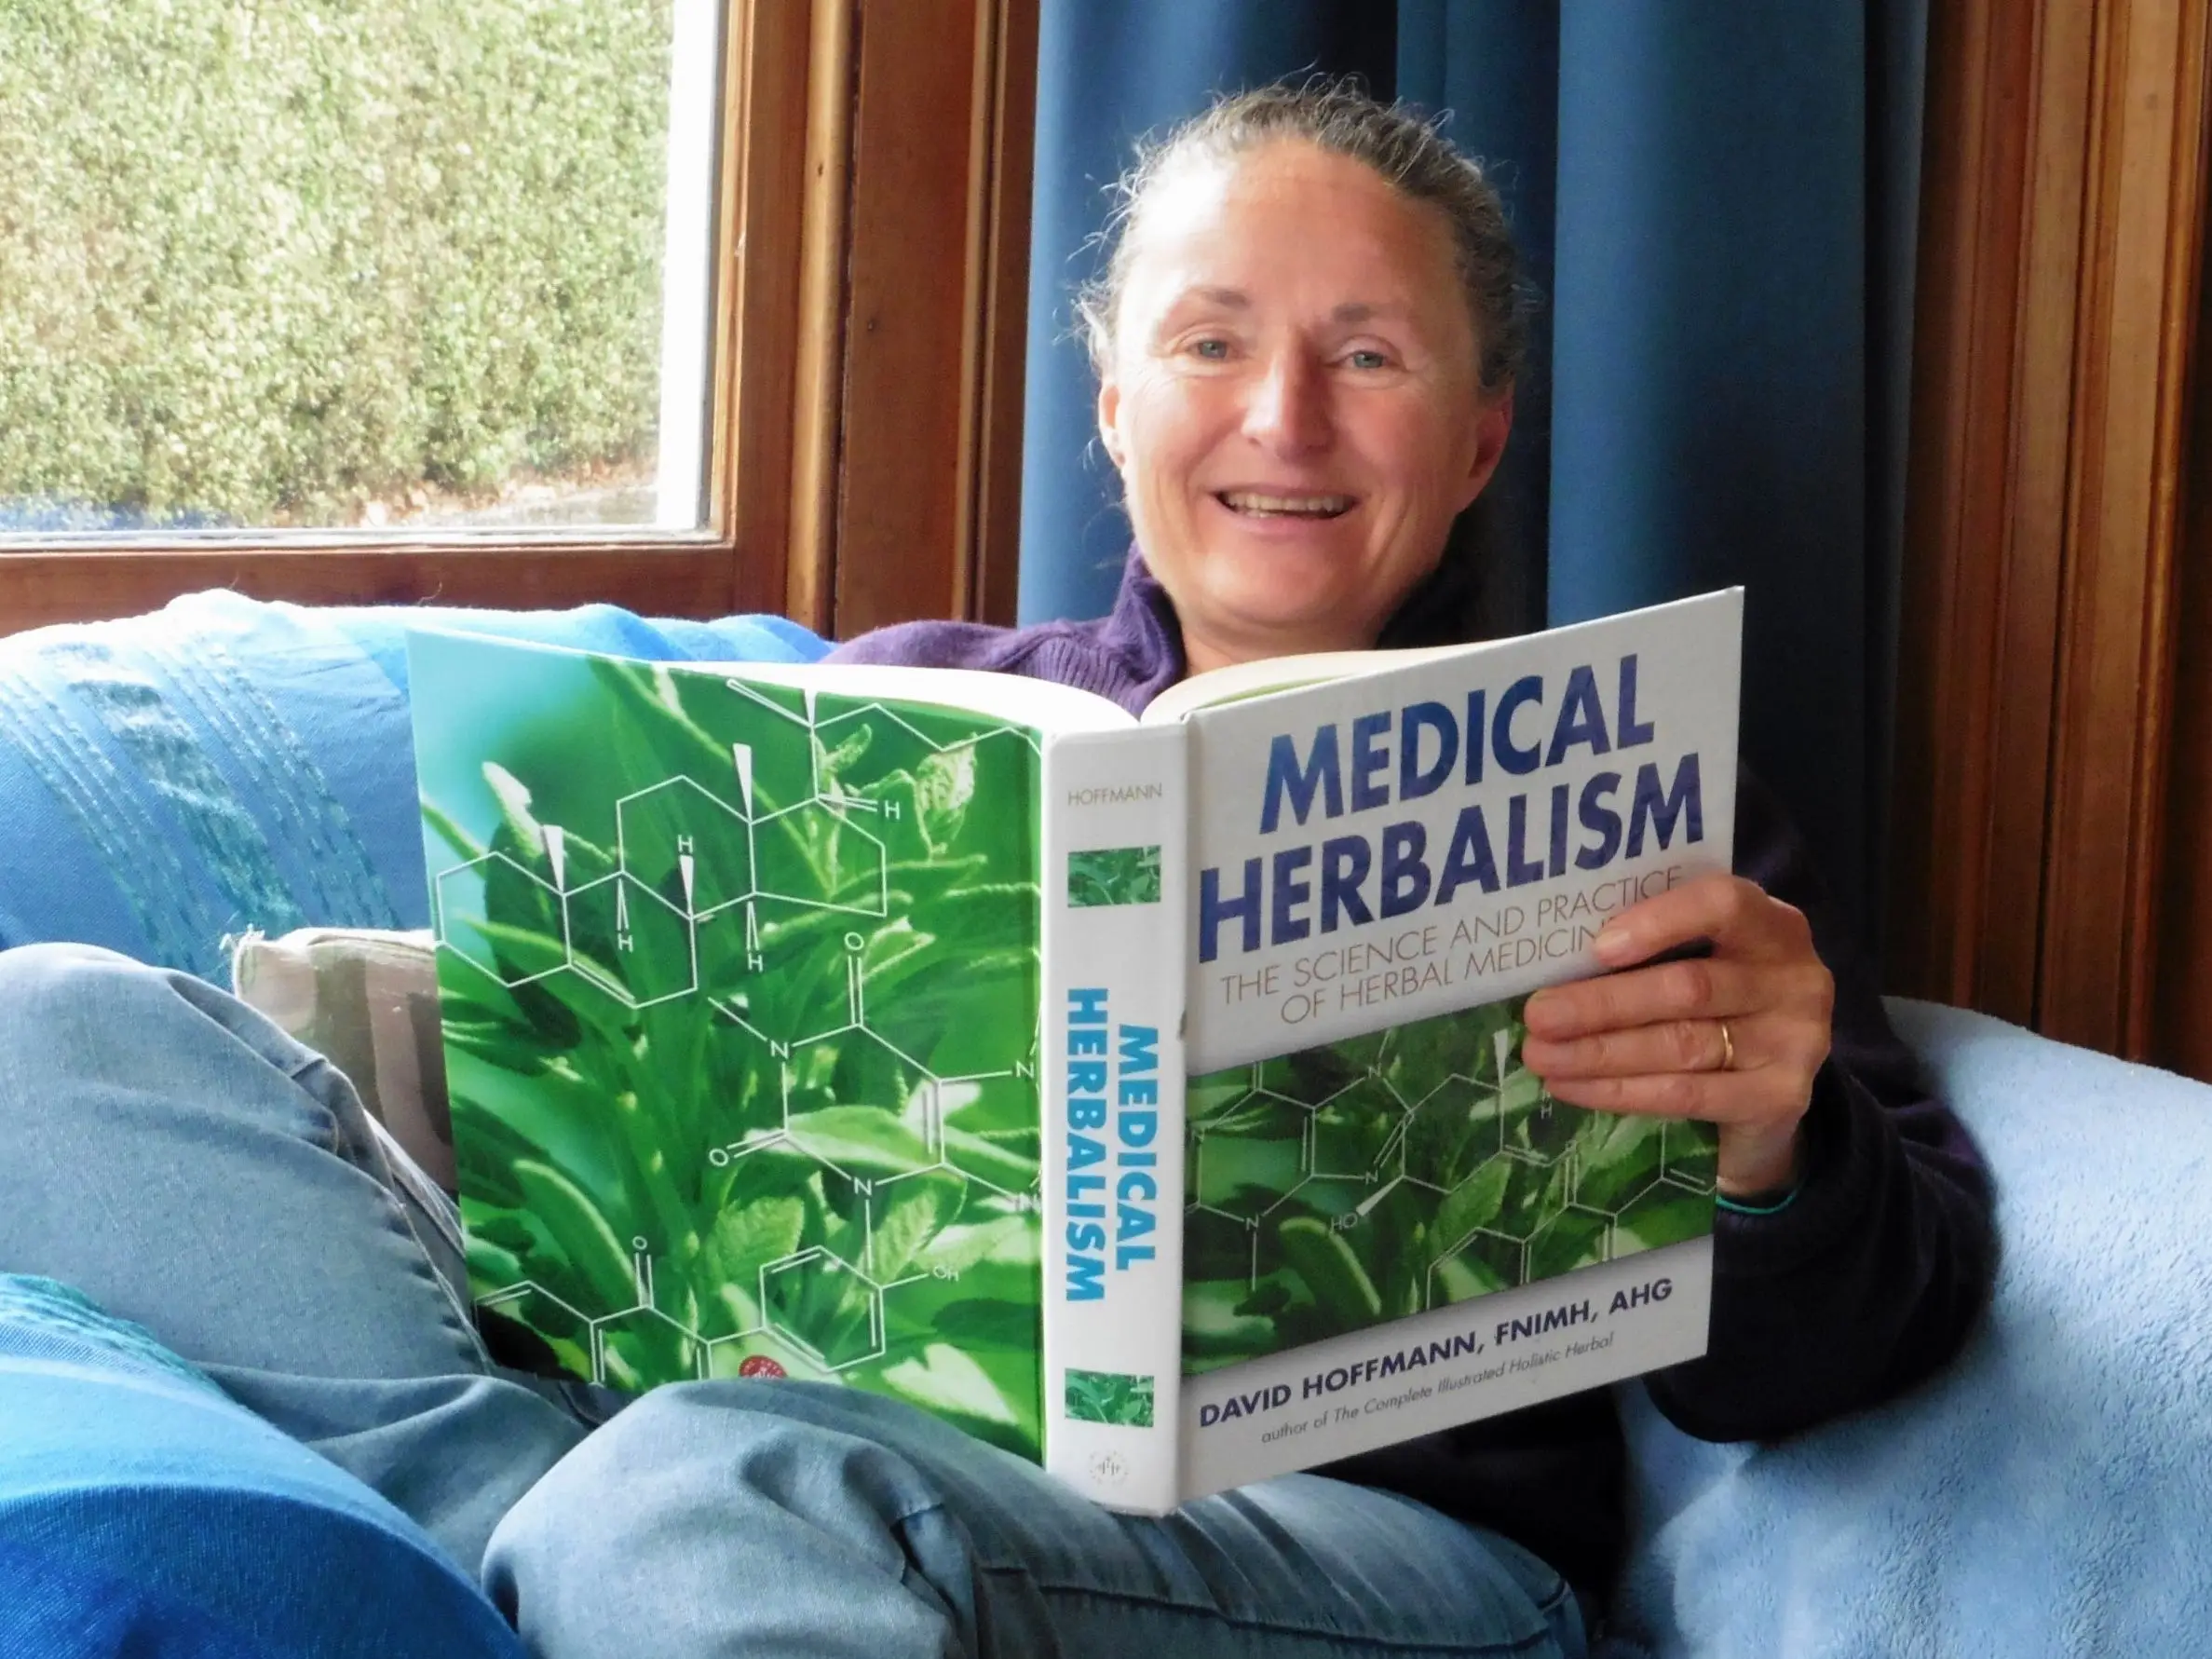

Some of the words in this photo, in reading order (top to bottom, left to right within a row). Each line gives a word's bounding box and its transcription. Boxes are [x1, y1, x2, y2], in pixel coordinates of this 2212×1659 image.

[1067, 782, 1162, 807] HOFFMANN
[1259, 654, 1654, 834] MEDICAL
[1198, 753, 1703, 963] HERBALISM
[1222, 965, 1280, 1004] THE
[1294, 926, 1437, 987] SCIENCE
[1450, 906, 1525, 949] AND
[1538, 865, 1682, 927] PRACTICE
[1281, 989, 1325, 1024] OF
[1340, 958, 1453, 1011] HERBAL
[1465, 918, 1615, 980] MEDICIN
[1065, 988, 1108, 1301] HERBALISM
[1116, 1024, 1158, 1271] MEDICAL
[1200, 1383, 1292, 1427] DAVID
[1302, 1330, 1485, 1400] HOFFMANN,
[1495, 1299, 1598, 1345] FNIMH,
[1608, 1278, 1673, 1314] AHG
[1261, 1416, 1308, 1443] author
[1313, 1409, 1328, 1428] of
[1333, 1407, 1359, 1423] The
[1364, 1385, 1432, 1414] Complete
[1438, 1363, 1505, 1394] Illustrated
[1509, 1348, 1561, 1375] Holistic
[1565, 1331, 1614, 1359] Herbal
